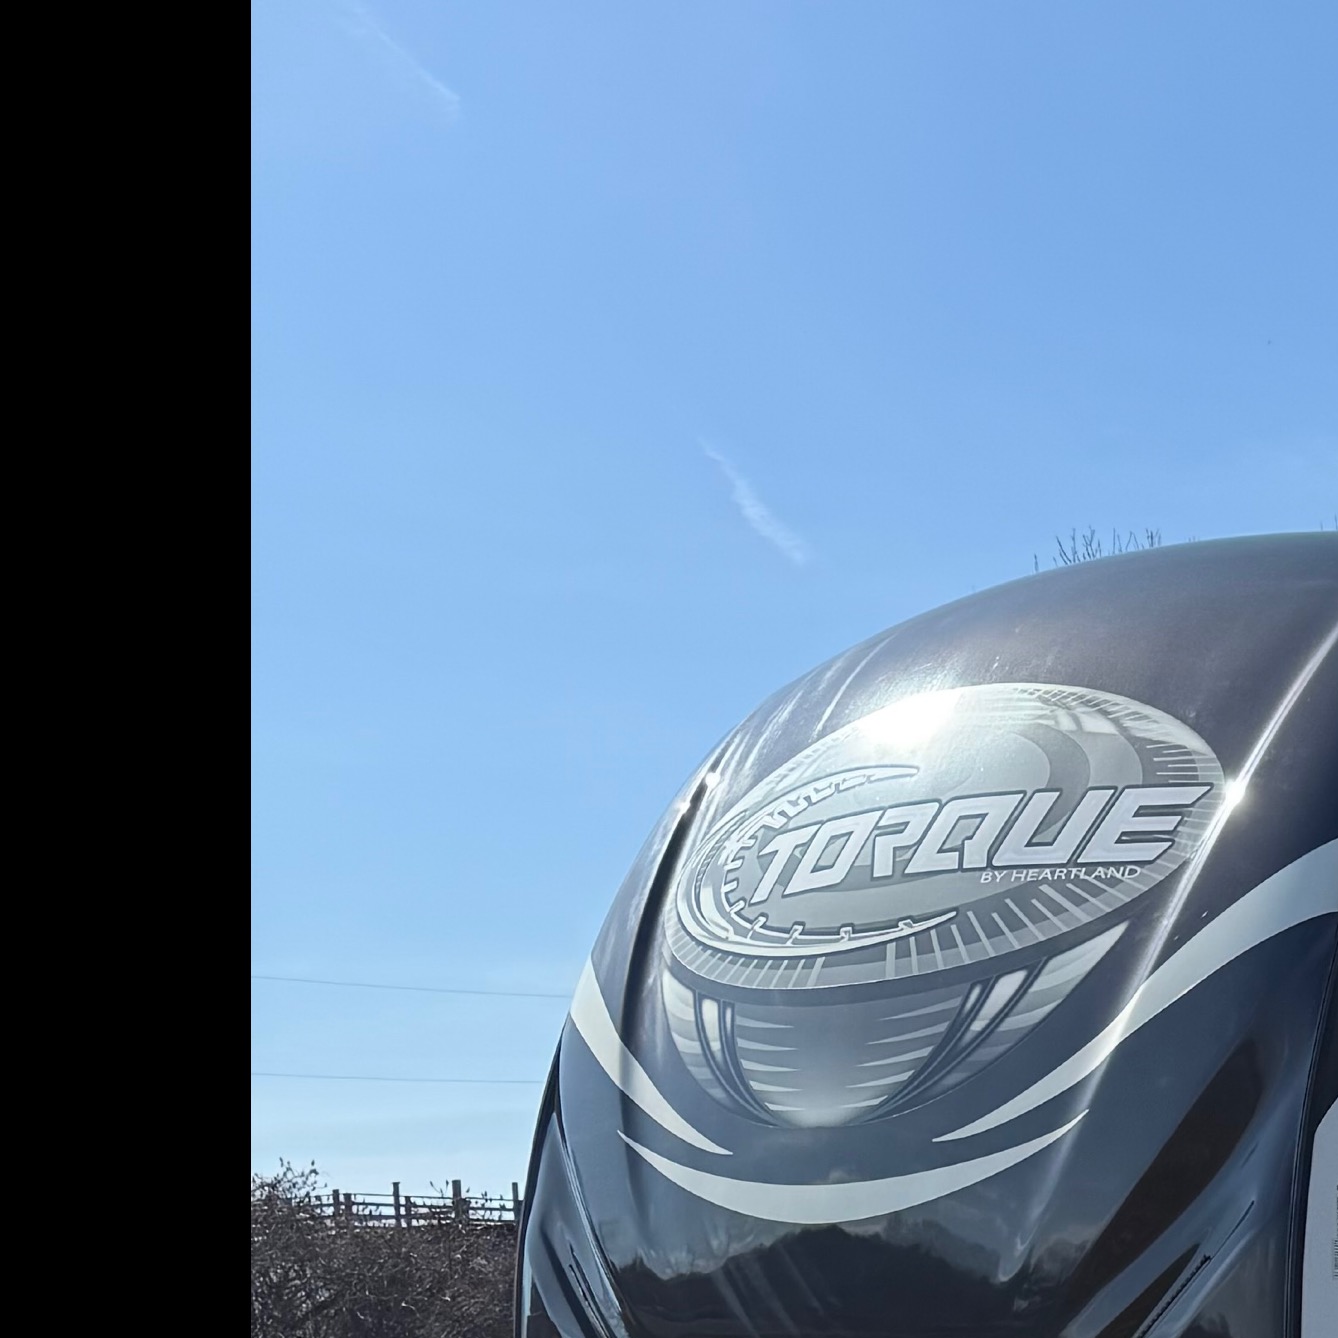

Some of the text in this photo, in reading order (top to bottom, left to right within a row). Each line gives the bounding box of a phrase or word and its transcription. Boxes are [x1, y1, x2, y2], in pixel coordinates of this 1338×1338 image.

[749, 785, 1213, 904] TORQUE
[980, 865, 1142, 884] BY HEARTLAND
